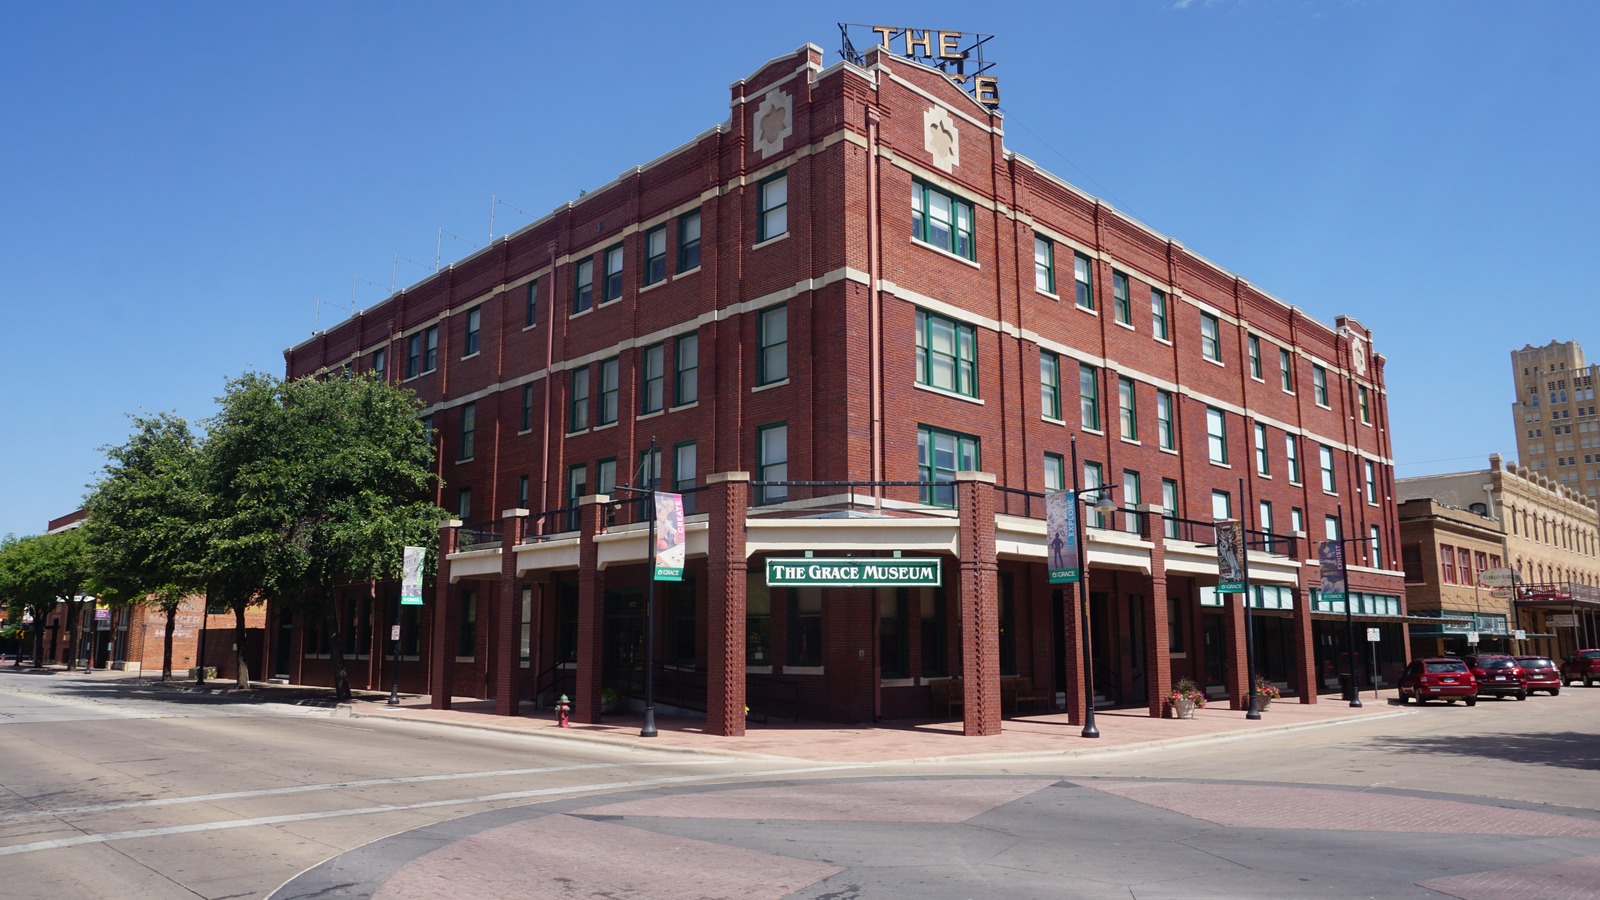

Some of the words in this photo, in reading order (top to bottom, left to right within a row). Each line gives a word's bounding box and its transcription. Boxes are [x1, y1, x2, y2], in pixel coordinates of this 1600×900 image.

[872, 25, 965, 59] THE
[675, 500, 684, 533] CREATE
[1067, 499, 1075, 537] EXPLORE
[773, 565, 806, 579] THE
[808, 565, 859, 579] GRACE
[863, 565, 934, 579] MUSEUM
[1335, 545, 1343, 570] EXHIBIT
